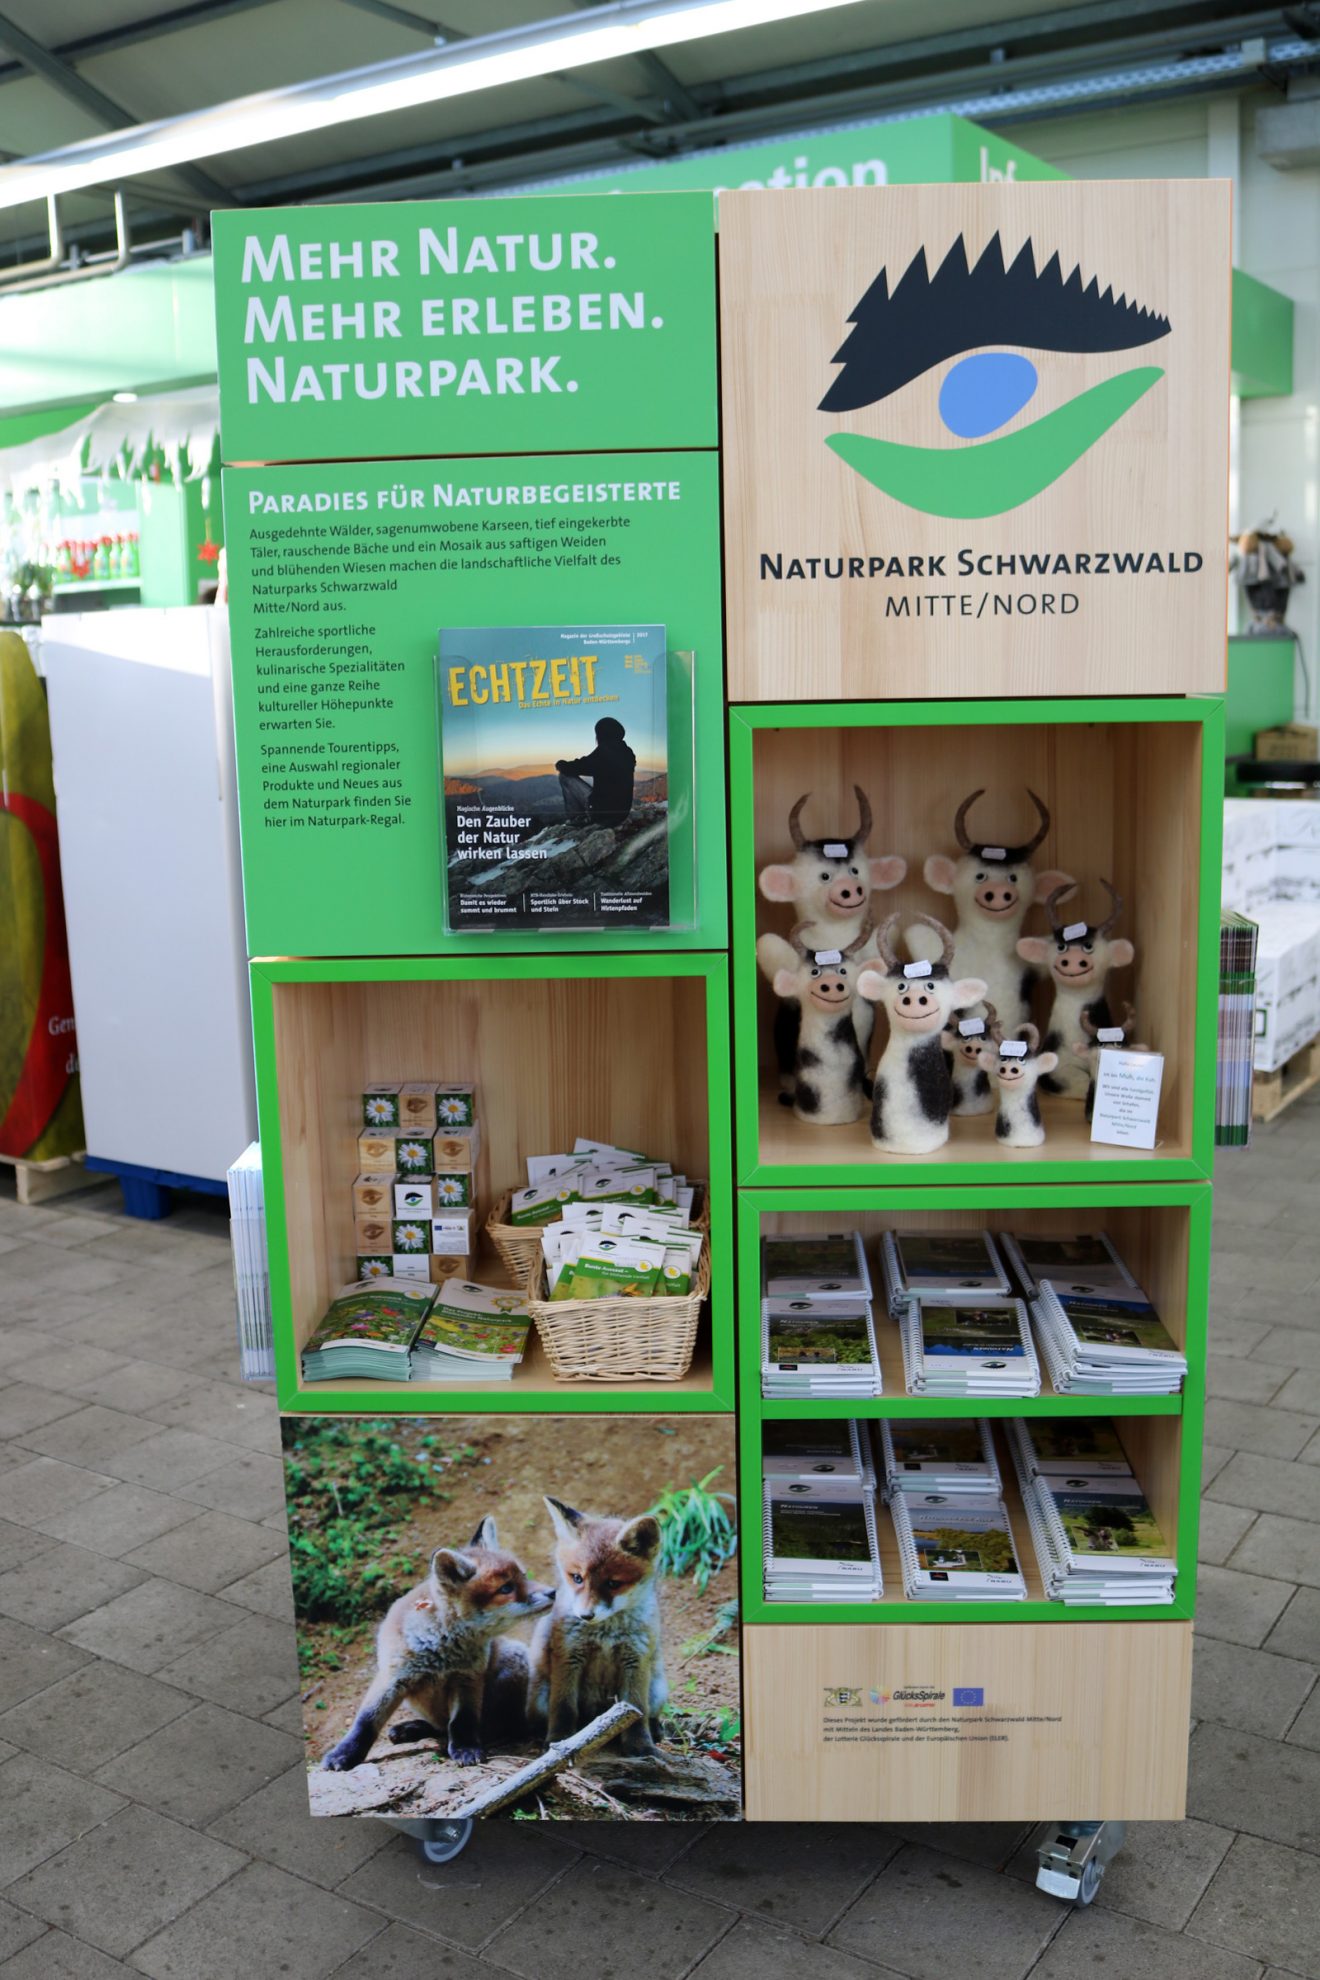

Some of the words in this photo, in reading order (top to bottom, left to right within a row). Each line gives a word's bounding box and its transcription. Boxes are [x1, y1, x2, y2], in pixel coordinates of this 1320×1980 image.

[242, 234, 400, 282] MEHR
[419, 228, 616, 274] NATUR.
[244, 295, 402, 343] MEHR
[421, 292, 663, 336] ERLEBEN.
[247, 356, 578, 402] NATURPARK.
[248, 491, 368, 513] PARADIES
[377, 484, 425, 508] FÜR
[433, 482, 680, 506] NATURBEGEISTERTE
[249, 526, 327, 542] Ausgedehnte
[328, 524, 374, 536] Wälder,
[375, 521, 478, 537] sagenumwobene
[481, 520, 532, 531] Karseen,
[534, 517, 556, 530] tief
[558, 516, 630, 531] eingekerbte
[250, 546, 280, 558] Täler,
[282, 544, 350, 557] rauschende
[353, 542, 389, 554] Bäche
[392, 541, 415, 553] und
[418, 540, 436, 552] ein
[439, 539, 482, 551] Mosaik
[485, 540, 506, 550] aus
[509, 537, 558, 552] saftigen
[560, 535, 606, 547] Weiden
[251, 564, 274, 577] und
[277, 563, 340, 575] blühenden
[342, 562, 386, 573] Wiesen
[389, 560, 437, 571] machen
[439, 558, 458, 570] die
[460, 556, 551, 569] landschaftliche
[554, 554, 597, 566] Vielfalt
[600, 554, 621, 565] des
[760, 554, 946, 579] NATURPARK
[957, 549, 1203, 575] SCHWARZWALD
[252, 582, 317, 596] Naturparks
[320, 579, 397, 592] Schwarzwald
[253, 600, 320, 613] Mitte/Nord
[322, 602, 346, 611] aus.
[885, 593, 1079, 617] MITTE/NORD
[254, 626, 315, 639] Zahlreiche
[317, 624, 376, 639] sportliche
[255, 644, 372, 657] Herausforderungen,
[256, 663, 326, 675] kulinarische
[328, 660, 405, 676] Spezialitäten
[257, 682, 280, 694] und
[282, 682, 307, 693] eine
[310, 683, 345, 695] ganze
[348, 679, 380, 691] Reihe
[448, 655, 600, 706] ECHTZEIT
[258, 700, 318, 712] kultureller
[320, 698, 393, 712] Höhepunkte
[259, 719, 312, 730] erwarten
[315, 717, 335, 729] Sie.
[260, 742, 325, 758] Spannende
[327, 741, 399, 754] Tourentipps,
[261, 762, 286, 773] eine
[288, 760, 338, 772] Auswahl
[341, 759, 400, 774] regionaler
[262, 779, 314, 791] Produkte
[317, 778, 340, 790] und
[342, 778, 379, 789] Neues
[382, 779, 402, 788] aus
[263, 798, 289, 809] dem
[292, 796, 351, 810] Naturpark
[353, 795, 391, 807] finden
[394, 795, 411, 806] Sie
[264, 816, 287, 827] hier
[289, 816, 305, 827] im
[307, 813, 405, 828] Naturpark-Regal.
[456, 815, 481, 827] Den
[485, 815, 531, 827] Zauber
[457, 830, 479, 843] der
[483, 831, 520, 843] Natur
[457, 847, 501, 859] wirken
[506, 847, 547, 859] lassen
